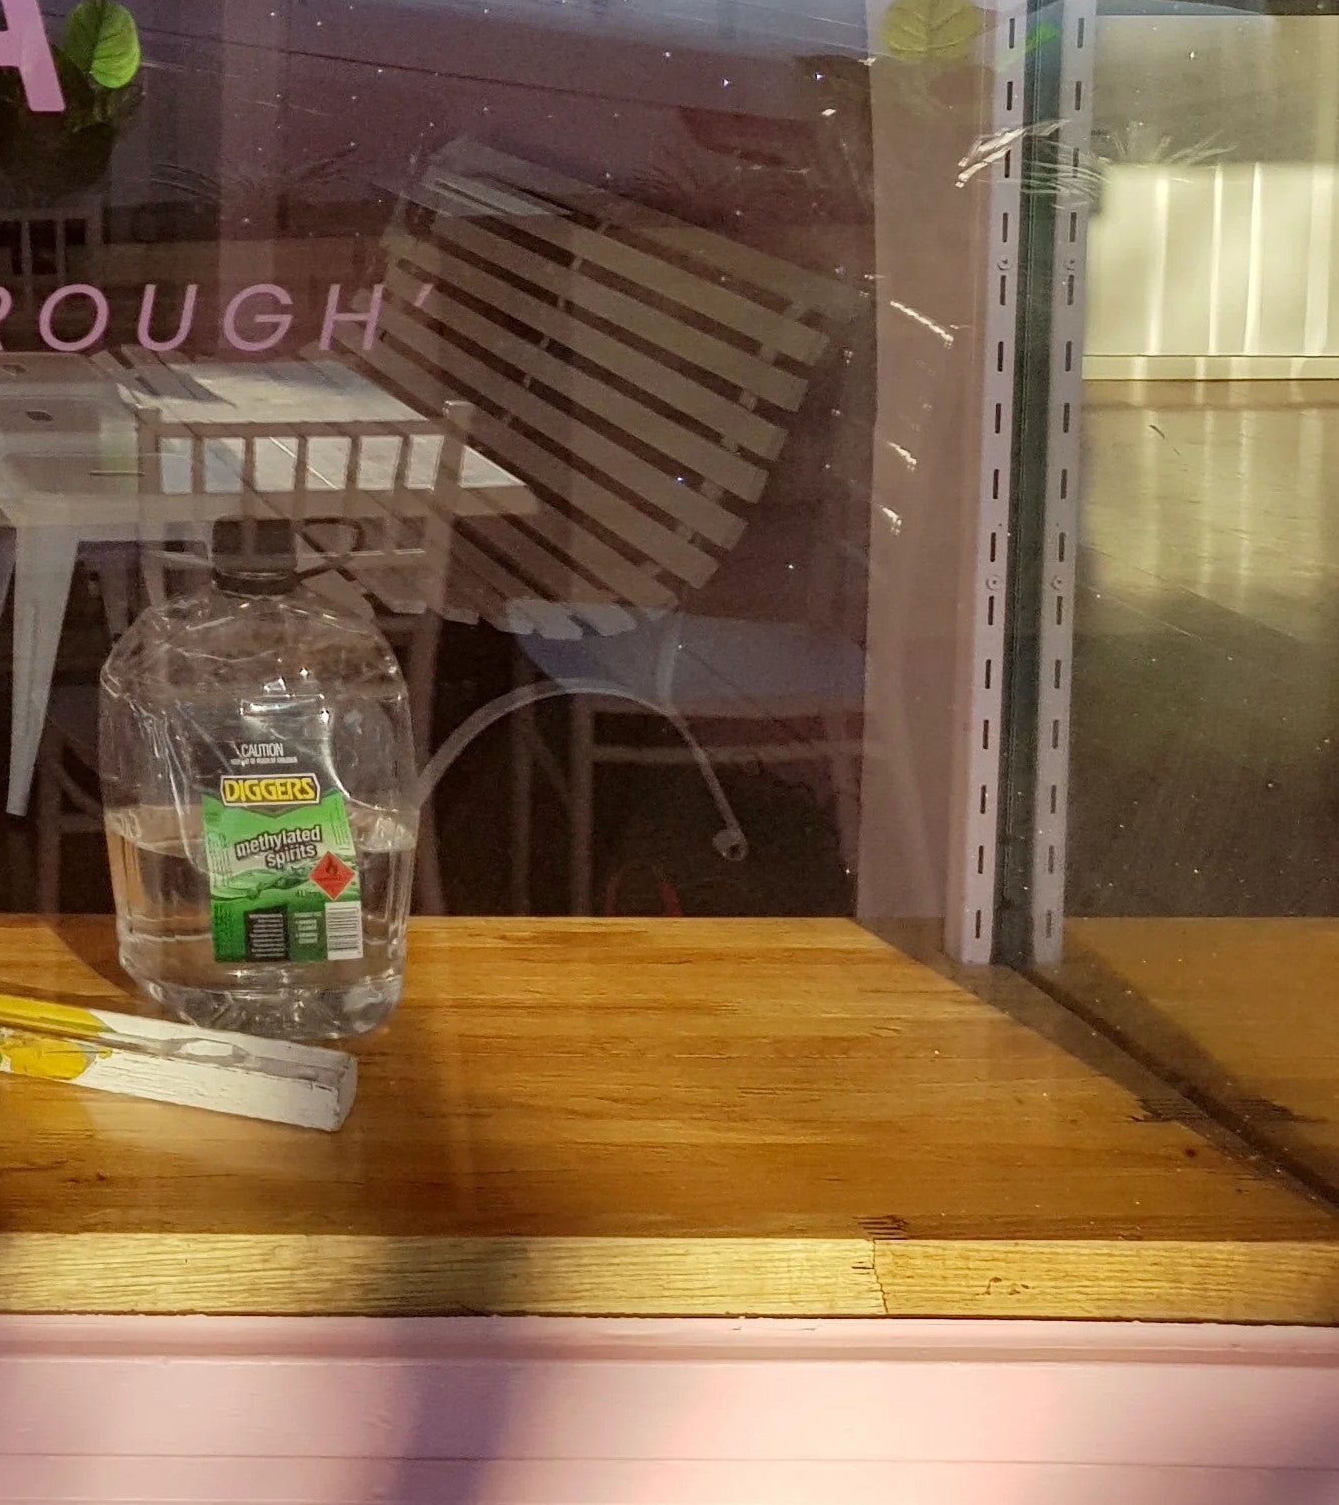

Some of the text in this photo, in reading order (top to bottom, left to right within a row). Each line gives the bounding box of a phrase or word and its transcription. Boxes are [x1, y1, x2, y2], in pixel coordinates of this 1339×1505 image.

[241, 742, 284, 758] CAUTION
[224, 777, 316, 802] DIGGERS
[236, 826, 321, 858] methylated
[267, 843, 317, 869] spirits
